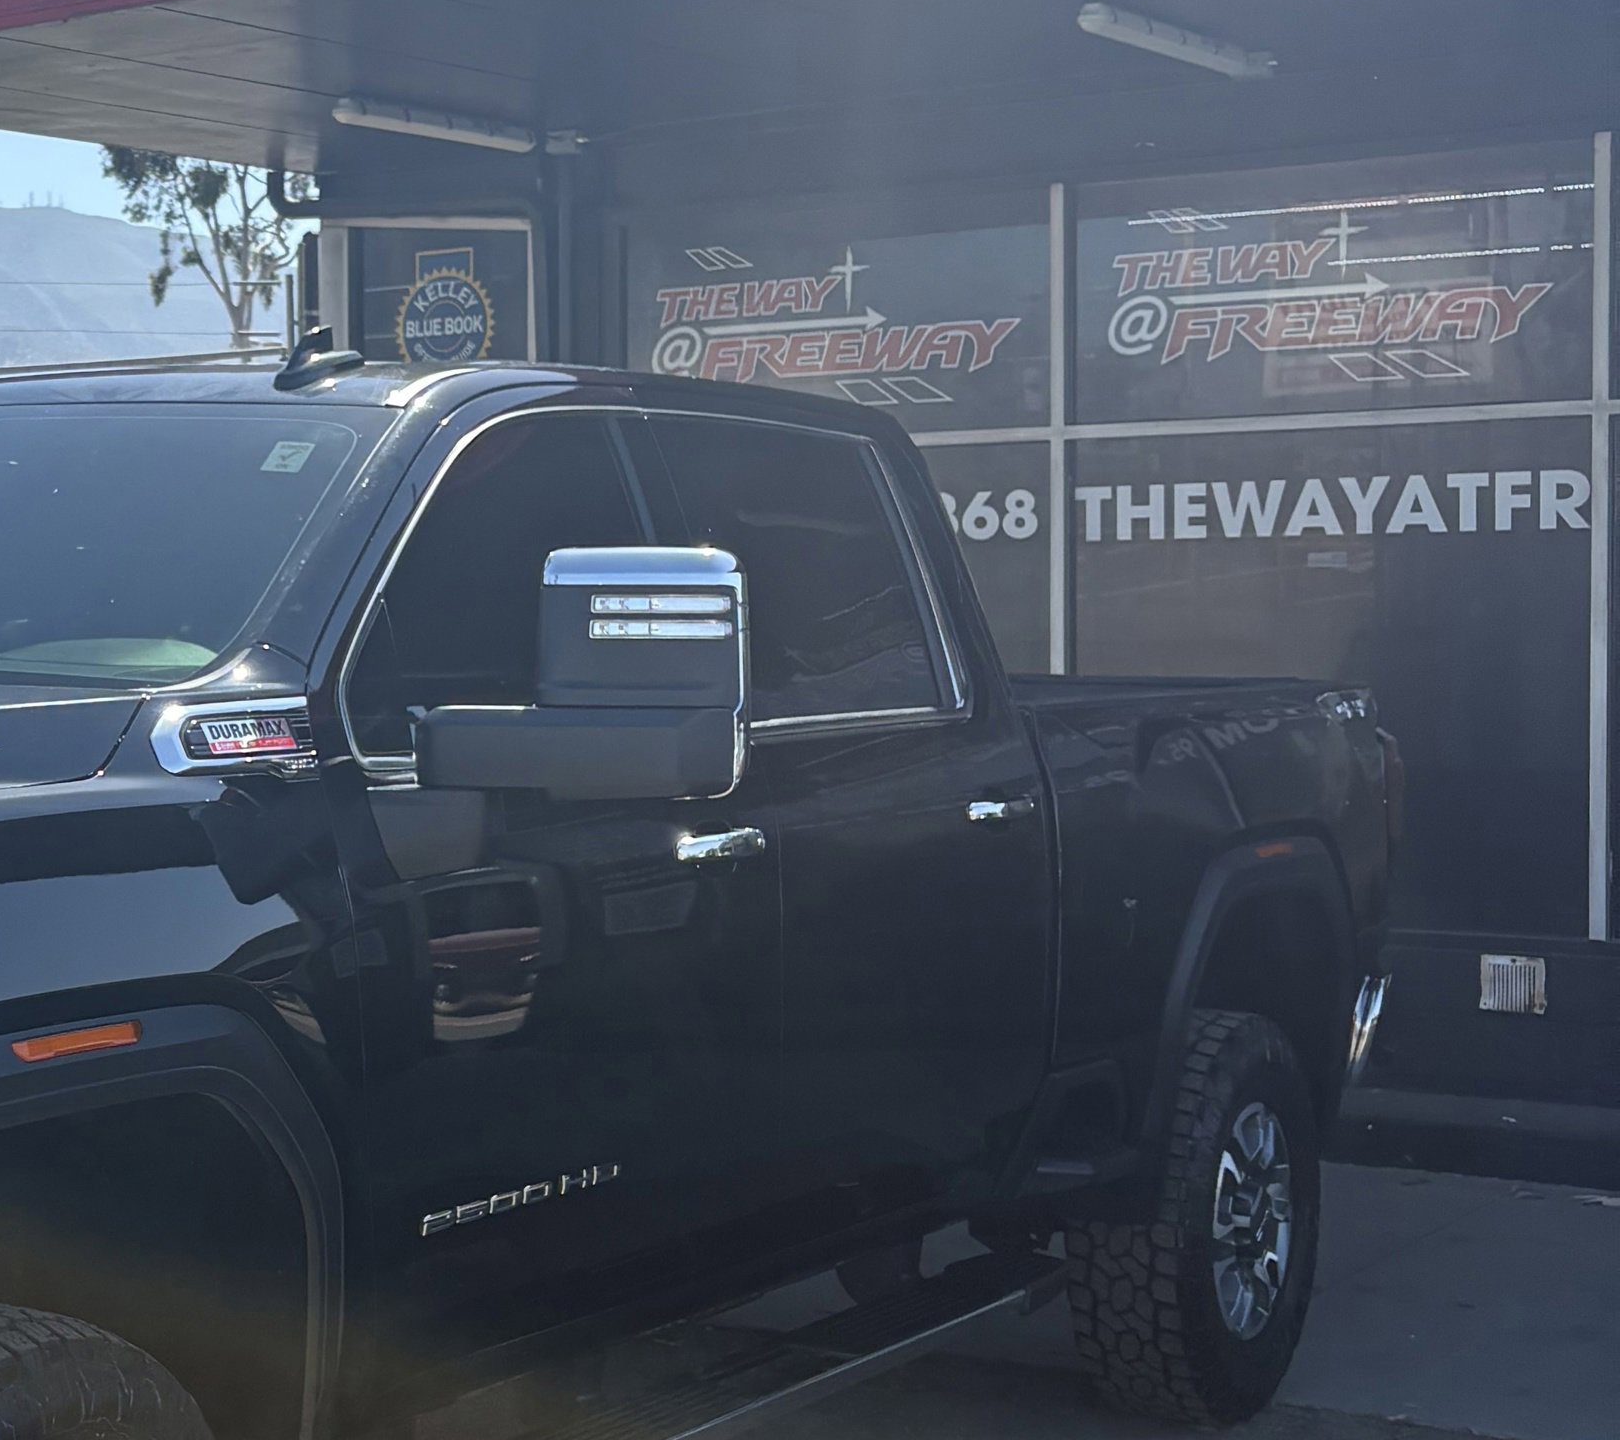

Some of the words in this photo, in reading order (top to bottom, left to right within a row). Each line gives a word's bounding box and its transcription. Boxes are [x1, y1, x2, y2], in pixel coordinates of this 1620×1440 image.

[413, 280, 479, 313] KELLEY
[405, 318, 443, 339] BLUE
[444, 315, 484, 336] BOOK
[1074, 469, 1593, 542] THEWAYATFR
[208, 717, 288, 741] DURAMAX
